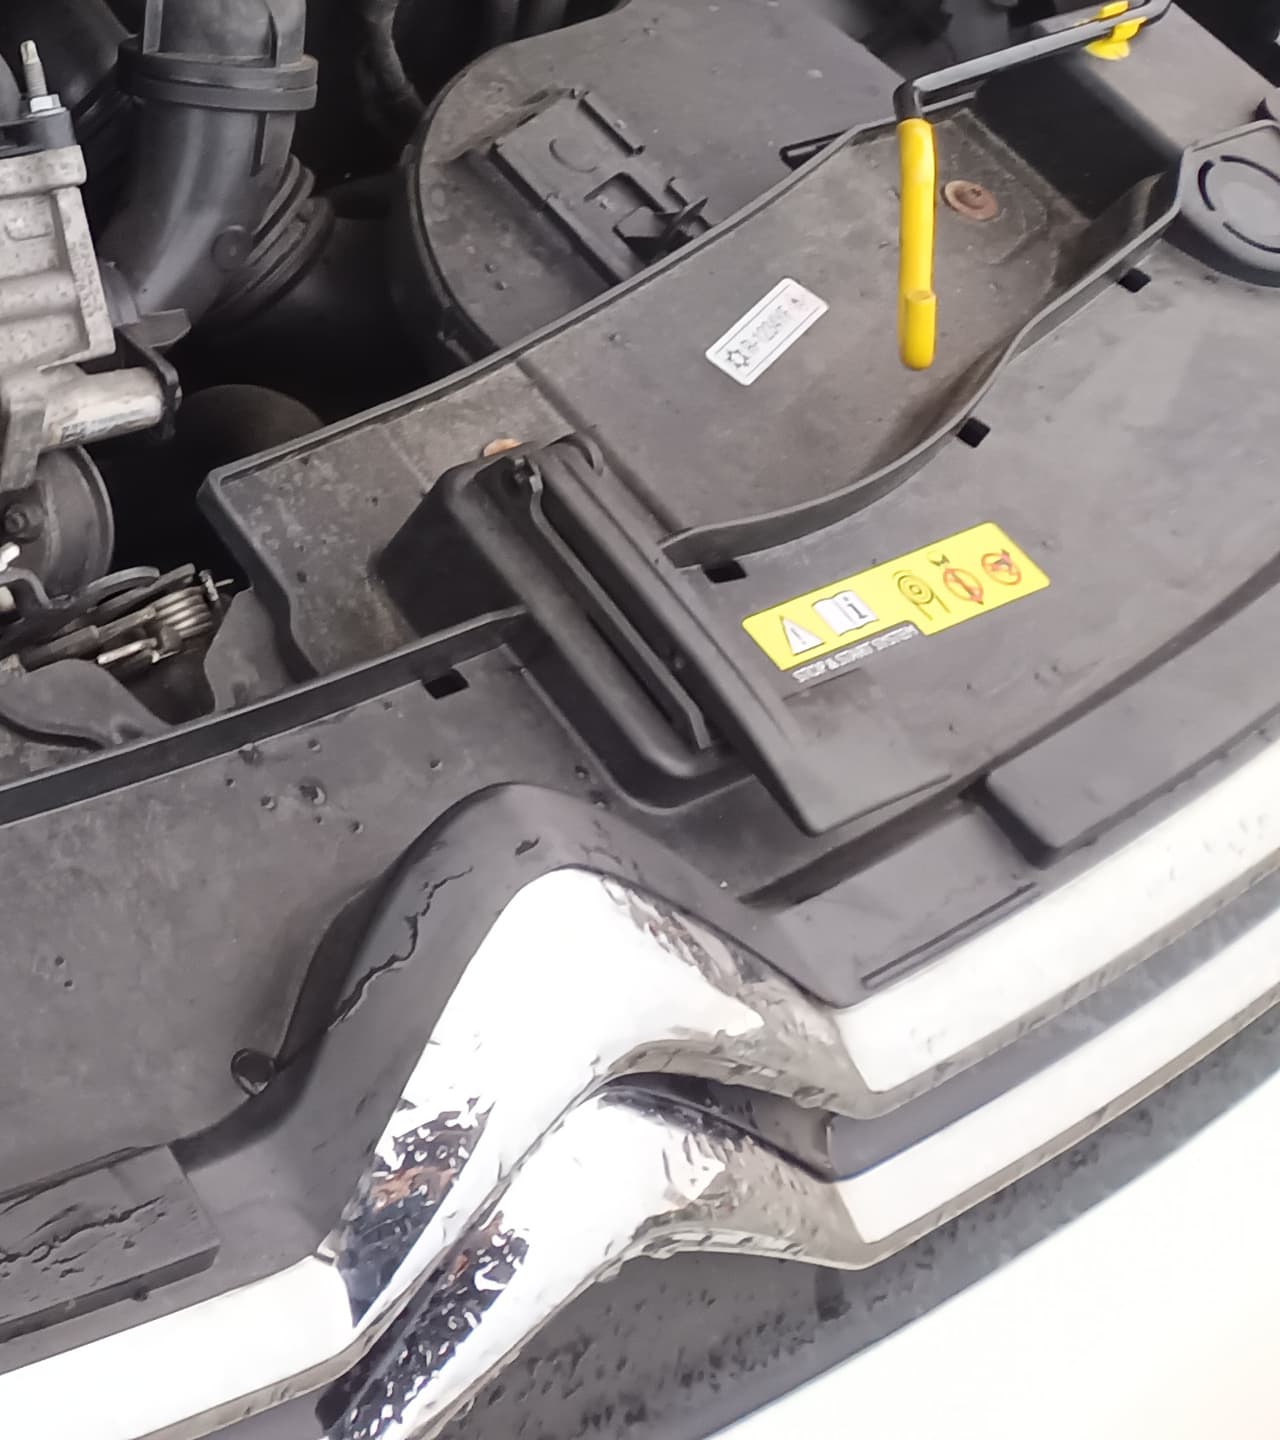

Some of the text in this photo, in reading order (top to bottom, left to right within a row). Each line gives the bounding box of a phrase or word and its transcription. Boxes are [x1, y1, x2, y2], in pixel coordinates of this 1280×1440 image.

[792, 660, 826, 683] STOP
[834, 641, 874, 666] START
[871, 624, 920, 651] SYSTEM
